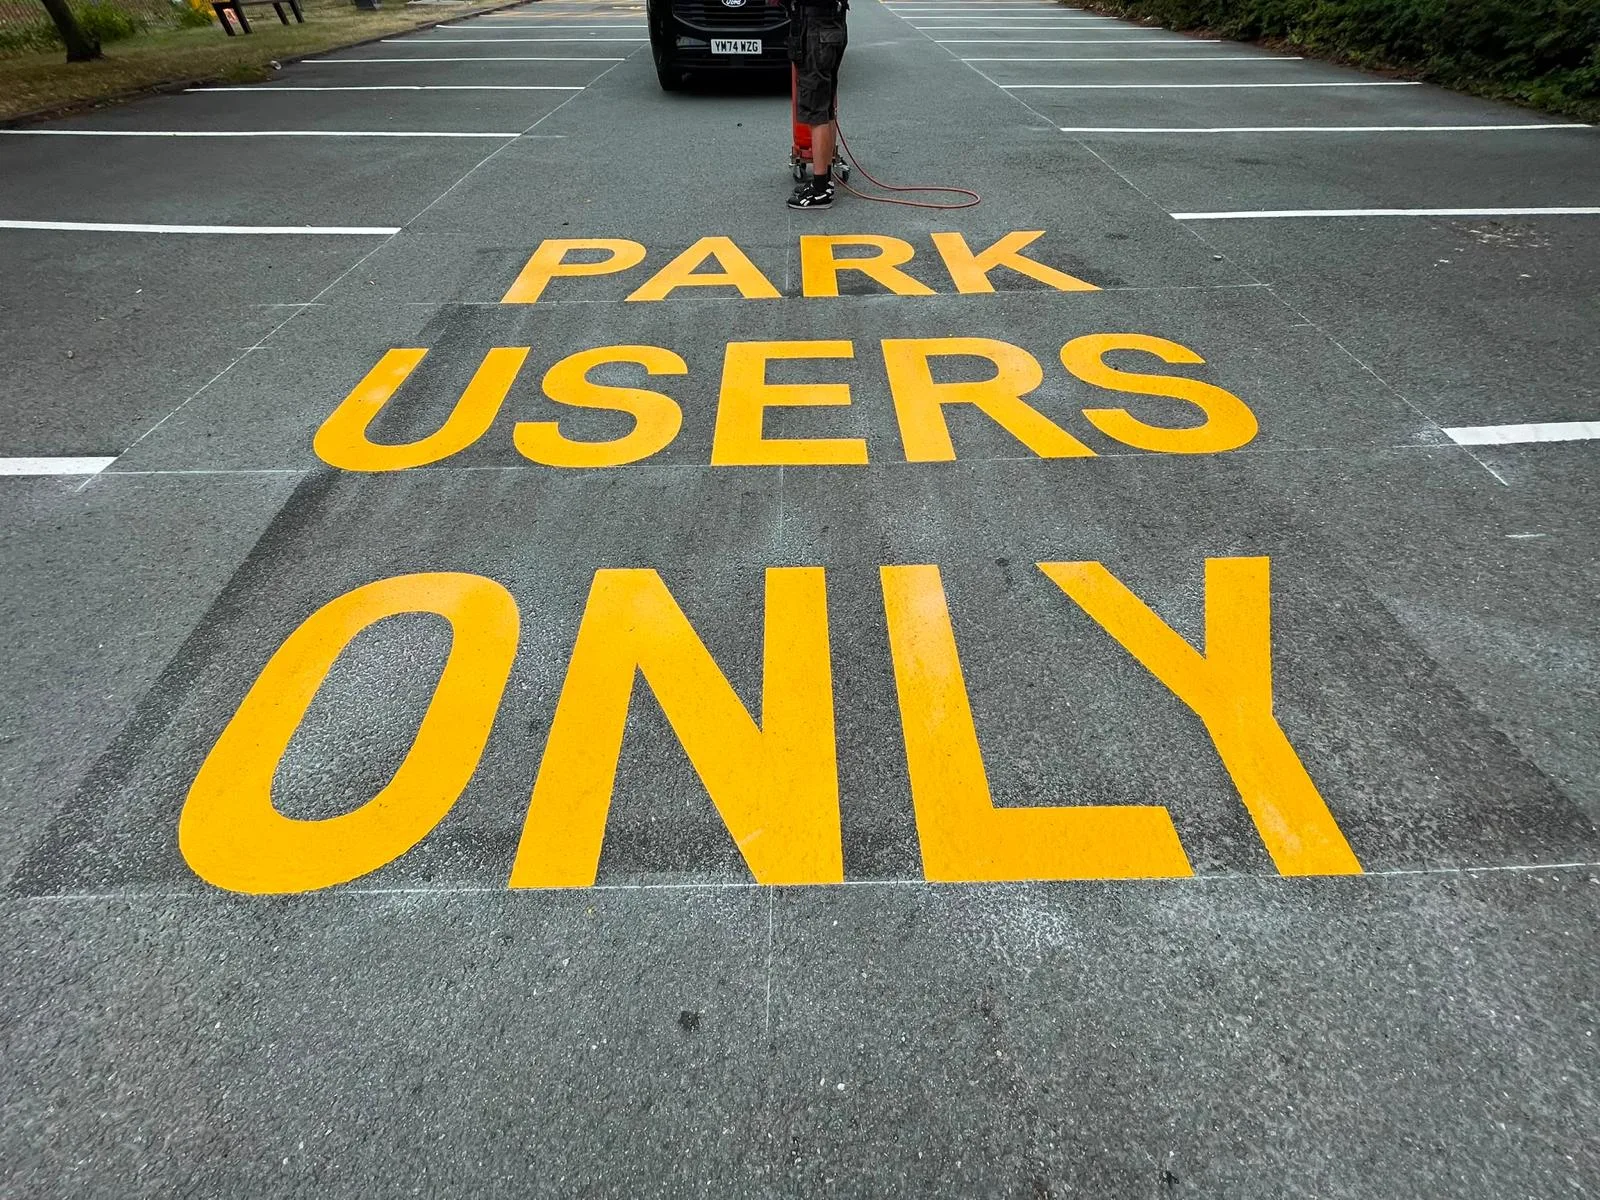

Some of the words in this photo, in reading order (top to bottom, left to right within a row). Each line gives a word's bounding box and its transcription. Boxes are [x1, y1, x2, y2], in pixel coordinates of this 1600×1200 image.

[714, 40, 738, 52] YM74
[502, 231, 1101, 304] PARK
[313, 333, 1260, 473] USERS
[178, 556, 1363, 896] ONLY
